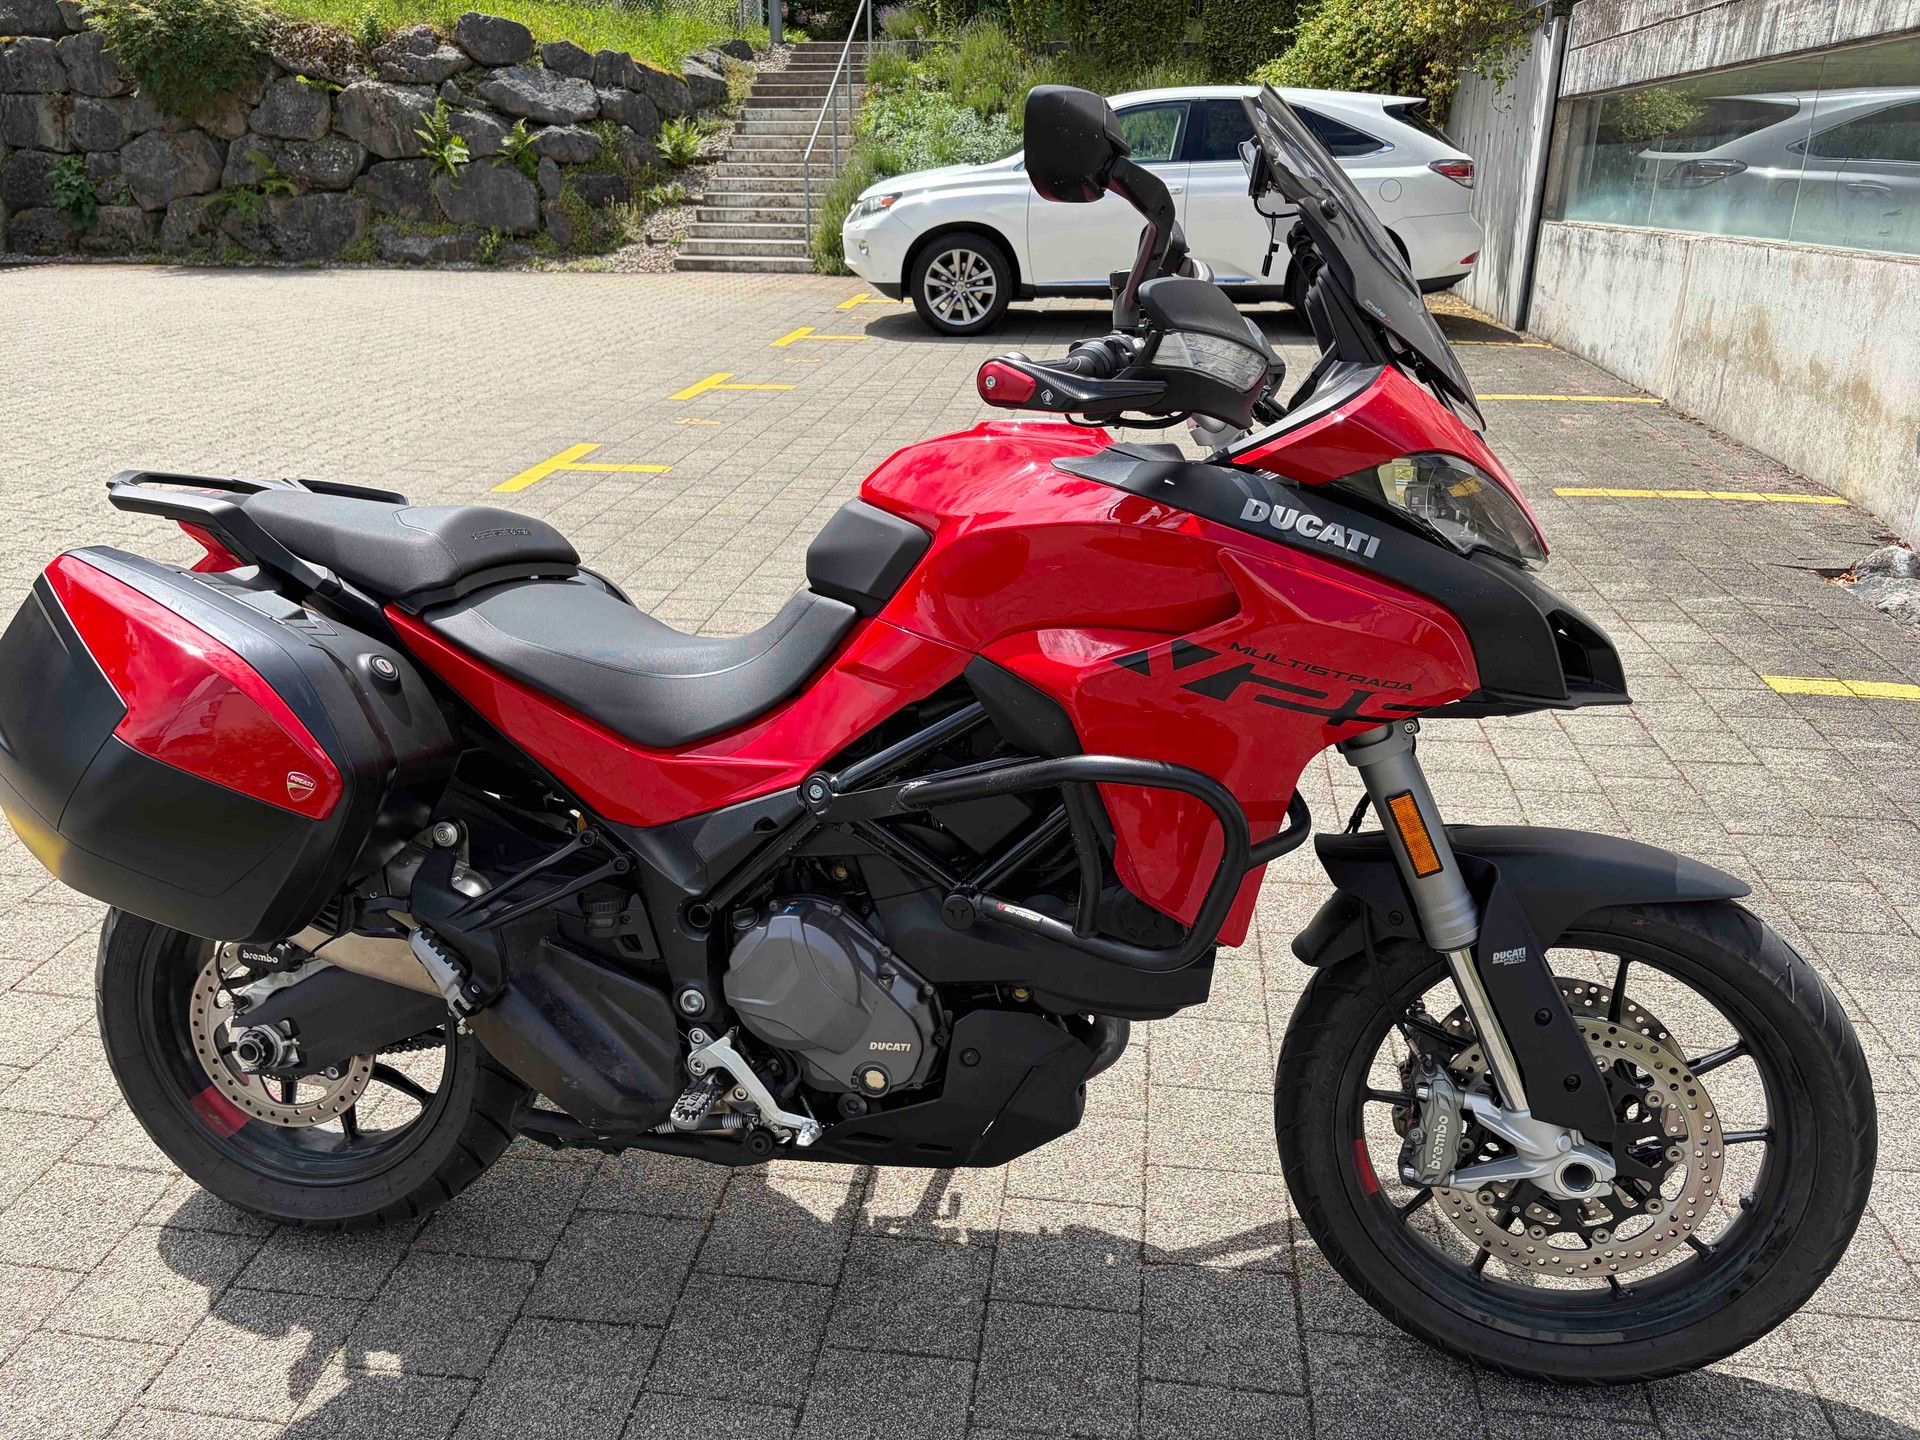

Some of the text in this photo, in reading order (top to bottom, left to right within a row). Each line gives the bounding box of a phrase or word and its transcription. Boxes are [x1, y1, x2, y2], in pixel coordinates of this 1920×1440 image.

[1240, 498, 1381, 559] DUCATI
[1229, 641, 1413, 691] MULTISTRADA
[290, 774, 314, 788] DUCATI
[242, 949, 279, 964] brembo
[1492, 947, 1526, 961] DUCATI
[869, 1041, 911, 1052] DUCATI
[1427, 1115, 1449, 1170] brembo
